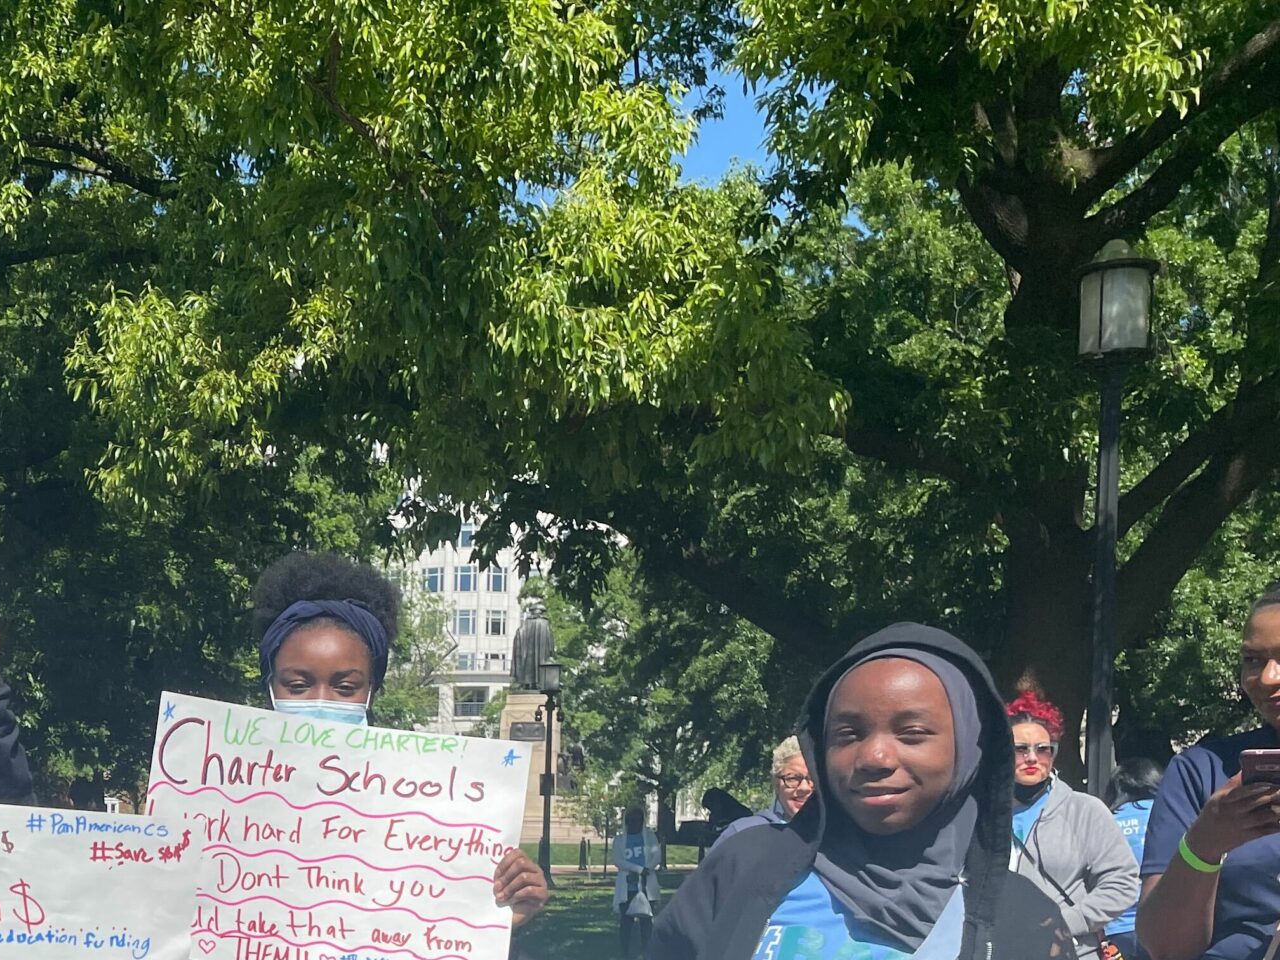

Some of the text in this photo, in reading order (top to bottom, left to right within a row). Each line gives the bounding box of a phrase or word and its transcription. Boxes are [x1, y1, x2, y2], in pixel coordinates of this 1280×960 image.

[158, 716, 486, 804] Charter Schools
[279, 721, 336, 750] LOVE
[345, 731, 469, 761] CHARTER!
[242, 815, 303, 845] hard
[211, 851, 290, 894] Dont
[371, 881, 447, 908] you
[235, 908, 281, 937] take
[285, 910, 356, 939] that
[371, 927, 413, 950] away
